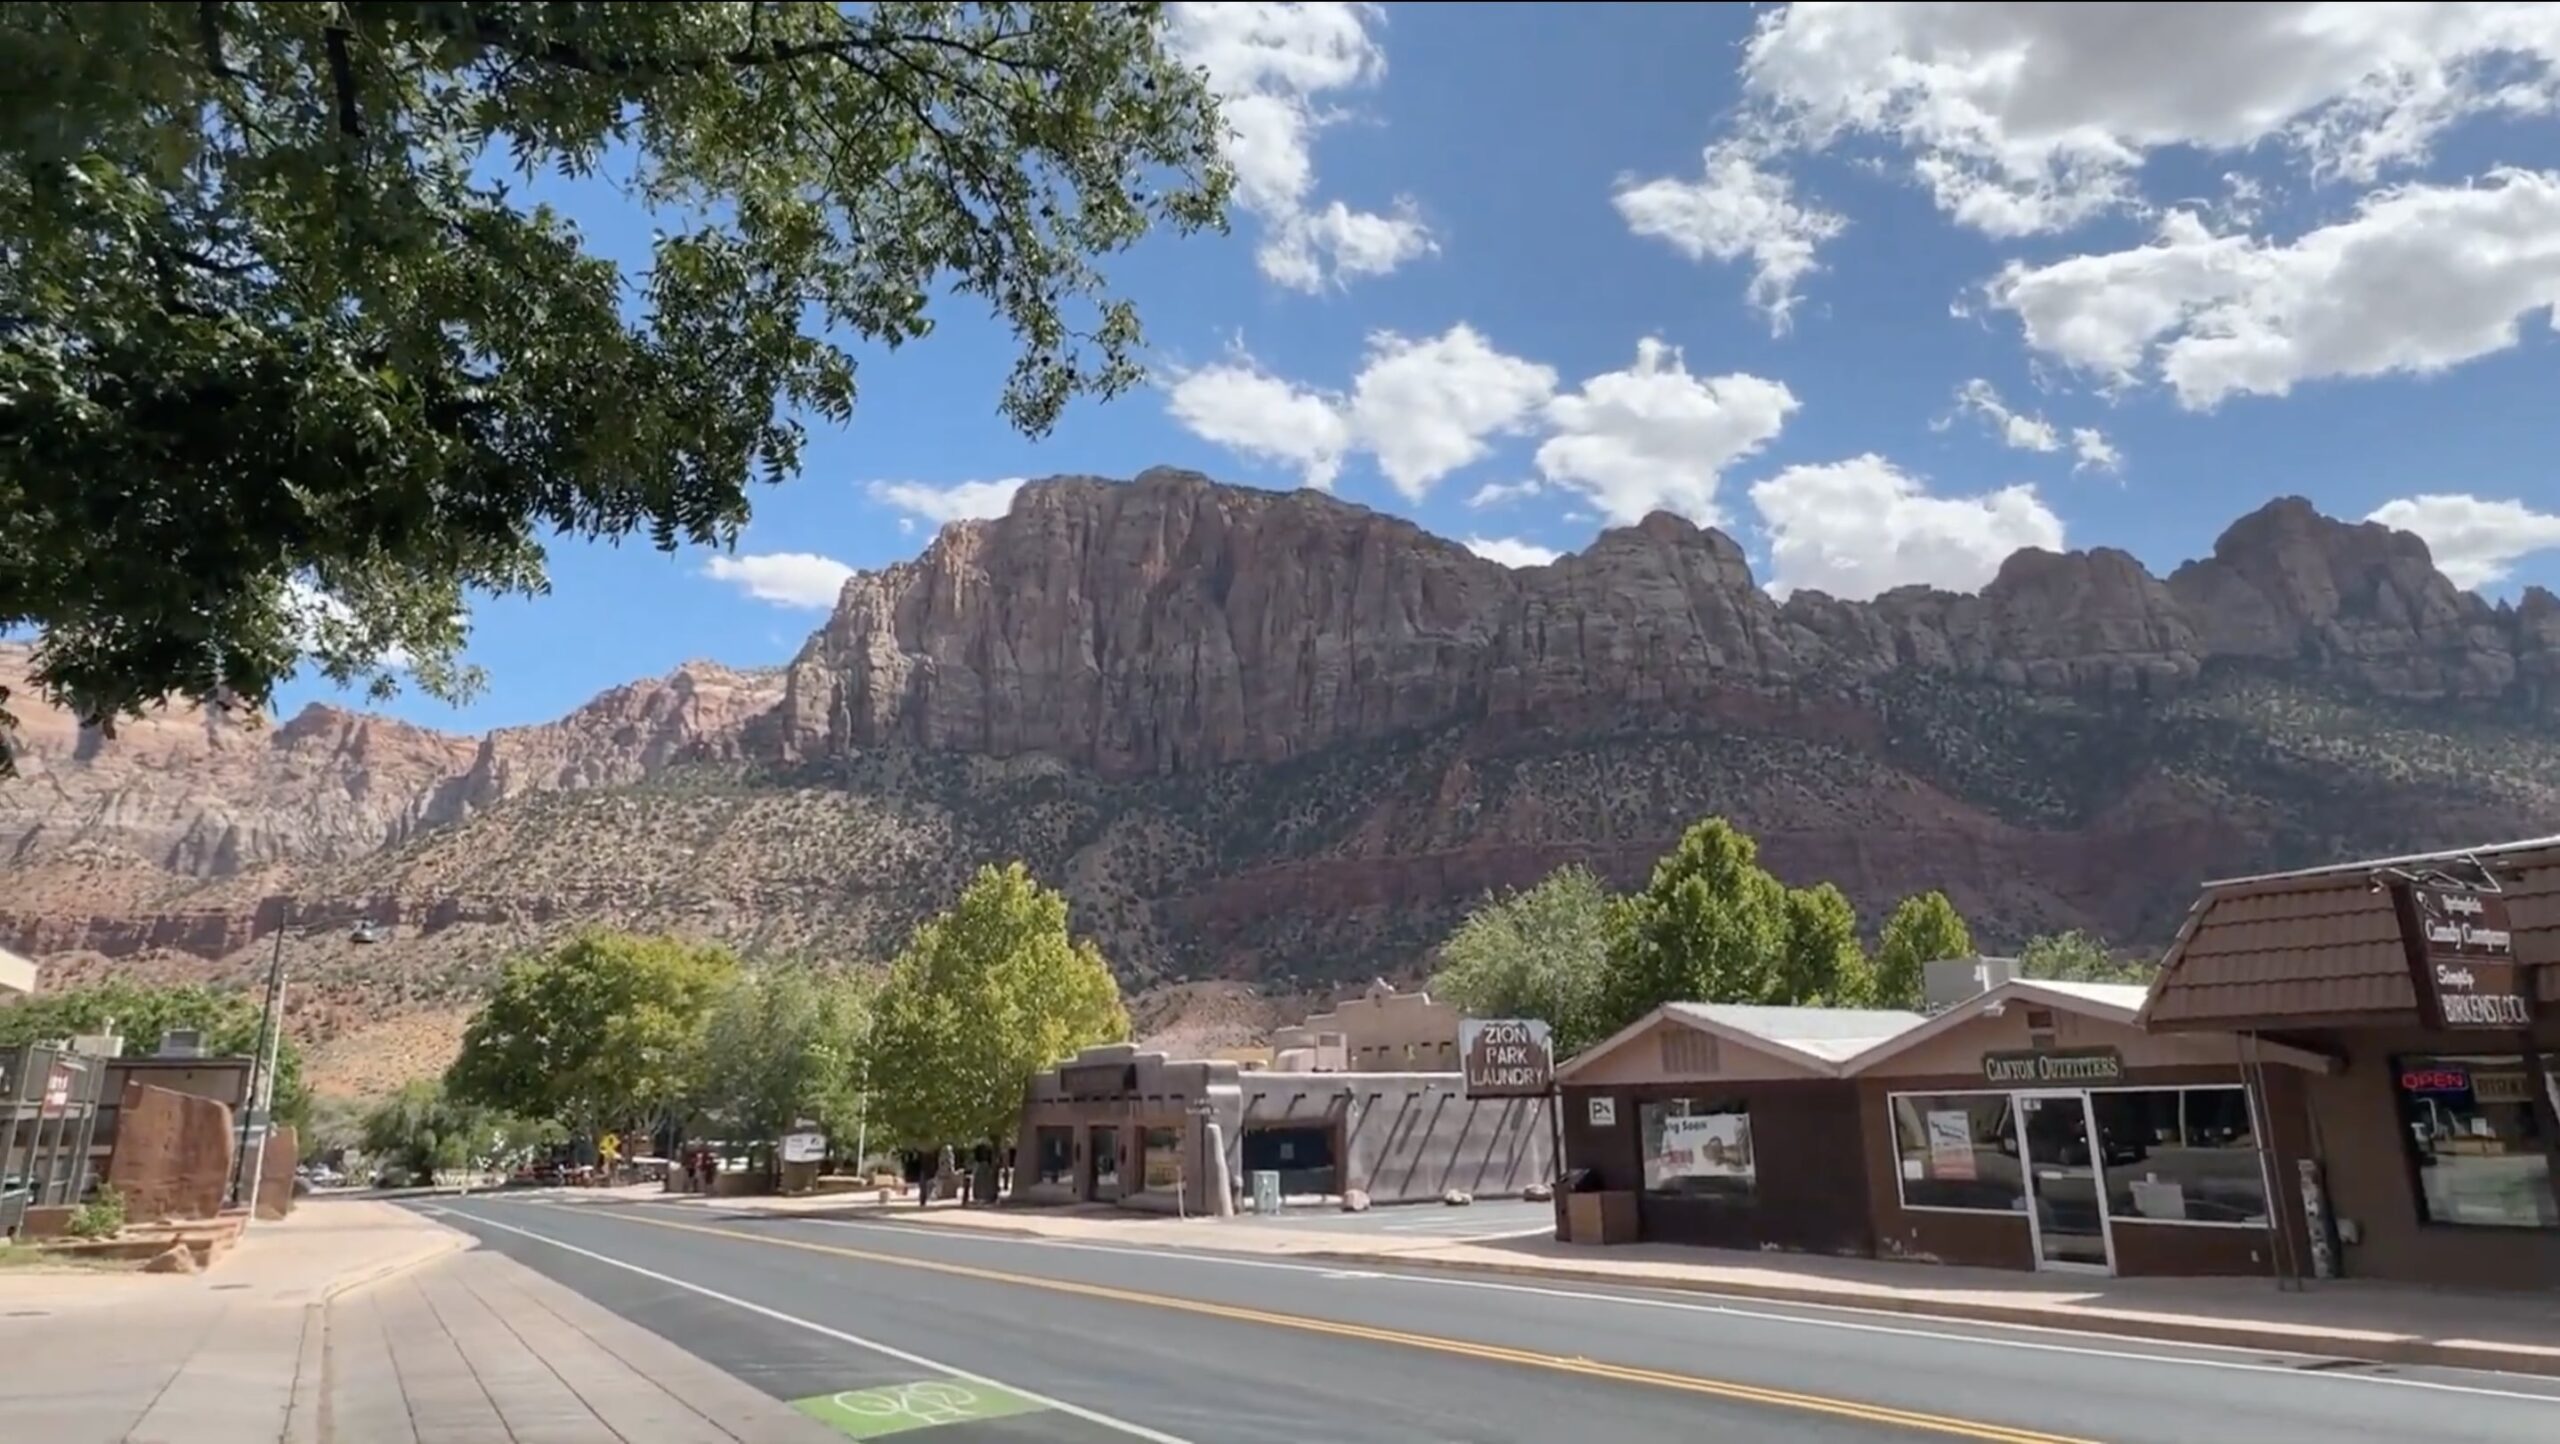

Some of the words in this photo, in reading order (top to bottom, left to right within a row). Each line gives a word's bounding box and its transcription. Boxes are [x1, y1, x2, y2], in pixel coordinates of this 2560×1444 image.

[2425, 918, 2461, 950] Candy
[2462, 923, 2511, 953] Company
[2441, 994, 2530, 1023] BIRKENSTOCK
[1484, 1025, 1527, 1044] ZION
[1485, 1045, 1529, 1065] PARK
[1470, 1067, 1544, 1087] LAUNDRY
[1986, 1058, 2036, 1081] CANYON
[2039, 1056, 2119, 1080] OUTFITTERS
[2402, 1072, 2464, 1090] OPEN
[1682, 1120, 1708, 1132] Soon
